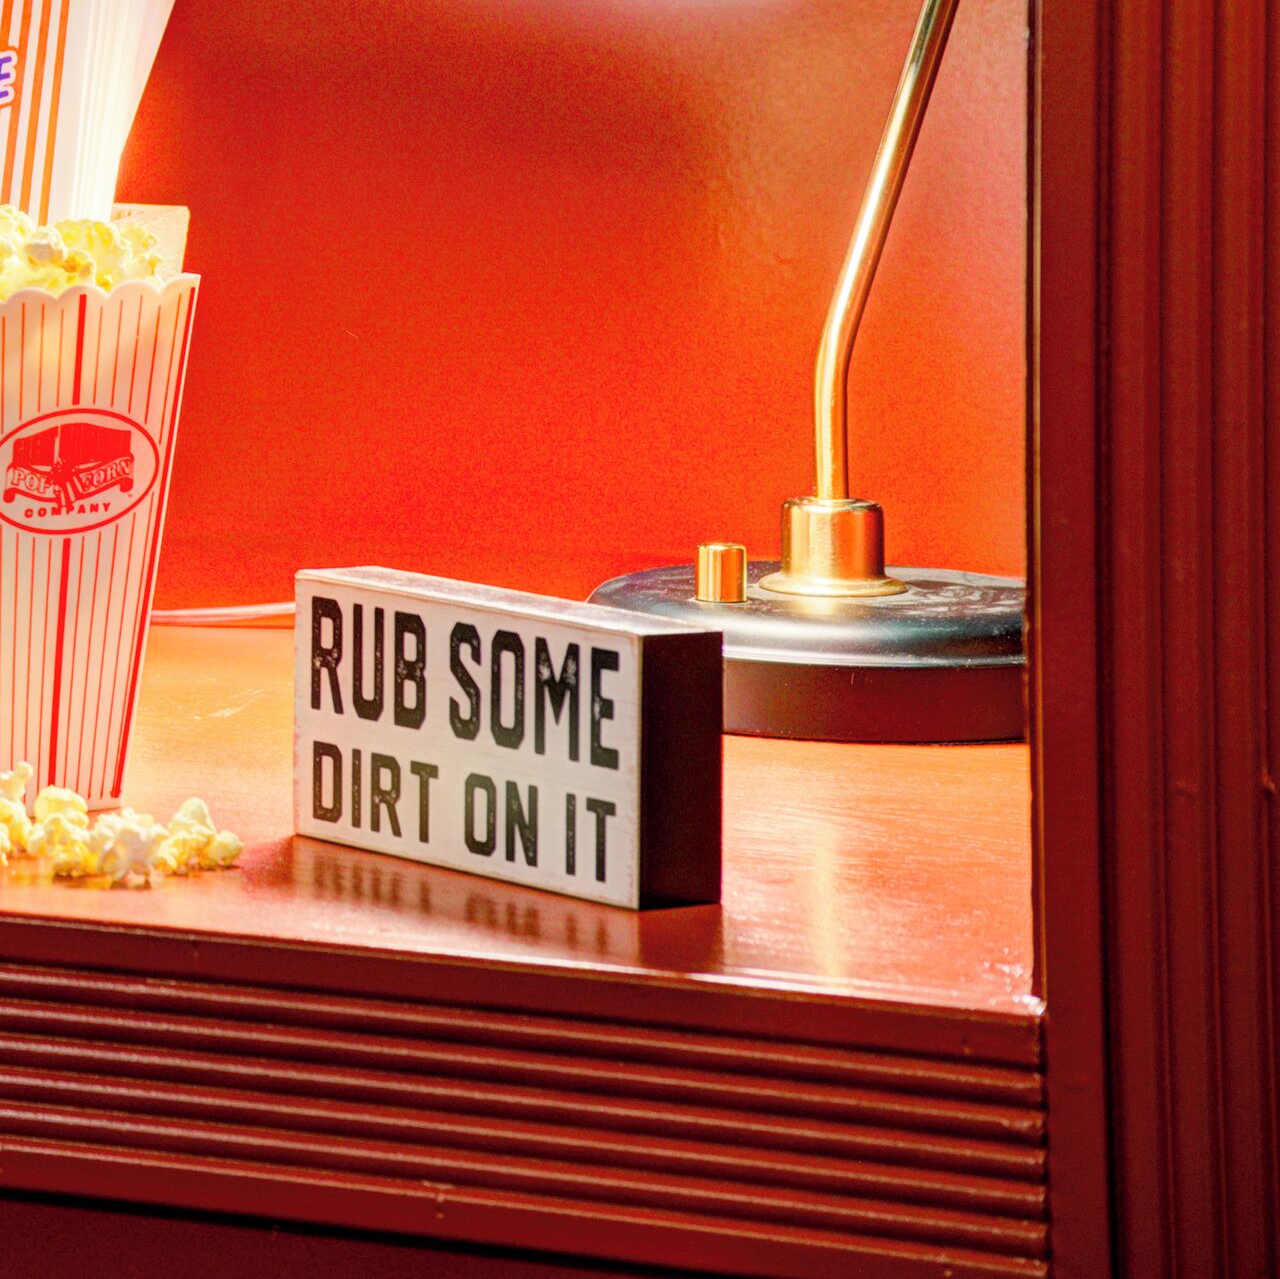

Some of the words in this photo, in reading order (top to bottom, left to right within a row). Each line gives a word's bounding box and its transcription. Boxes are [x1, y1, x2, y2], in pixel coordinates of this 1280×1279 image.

[24, 502, 111, 519] COMPANY
[311, 596, 427, 730] RUB
[449, 622, 620, 771] SOME
[312, 740, 439, 844] DIRT
[464, 772, 539, 868] ON
[565, 793, 617, 883] IT
